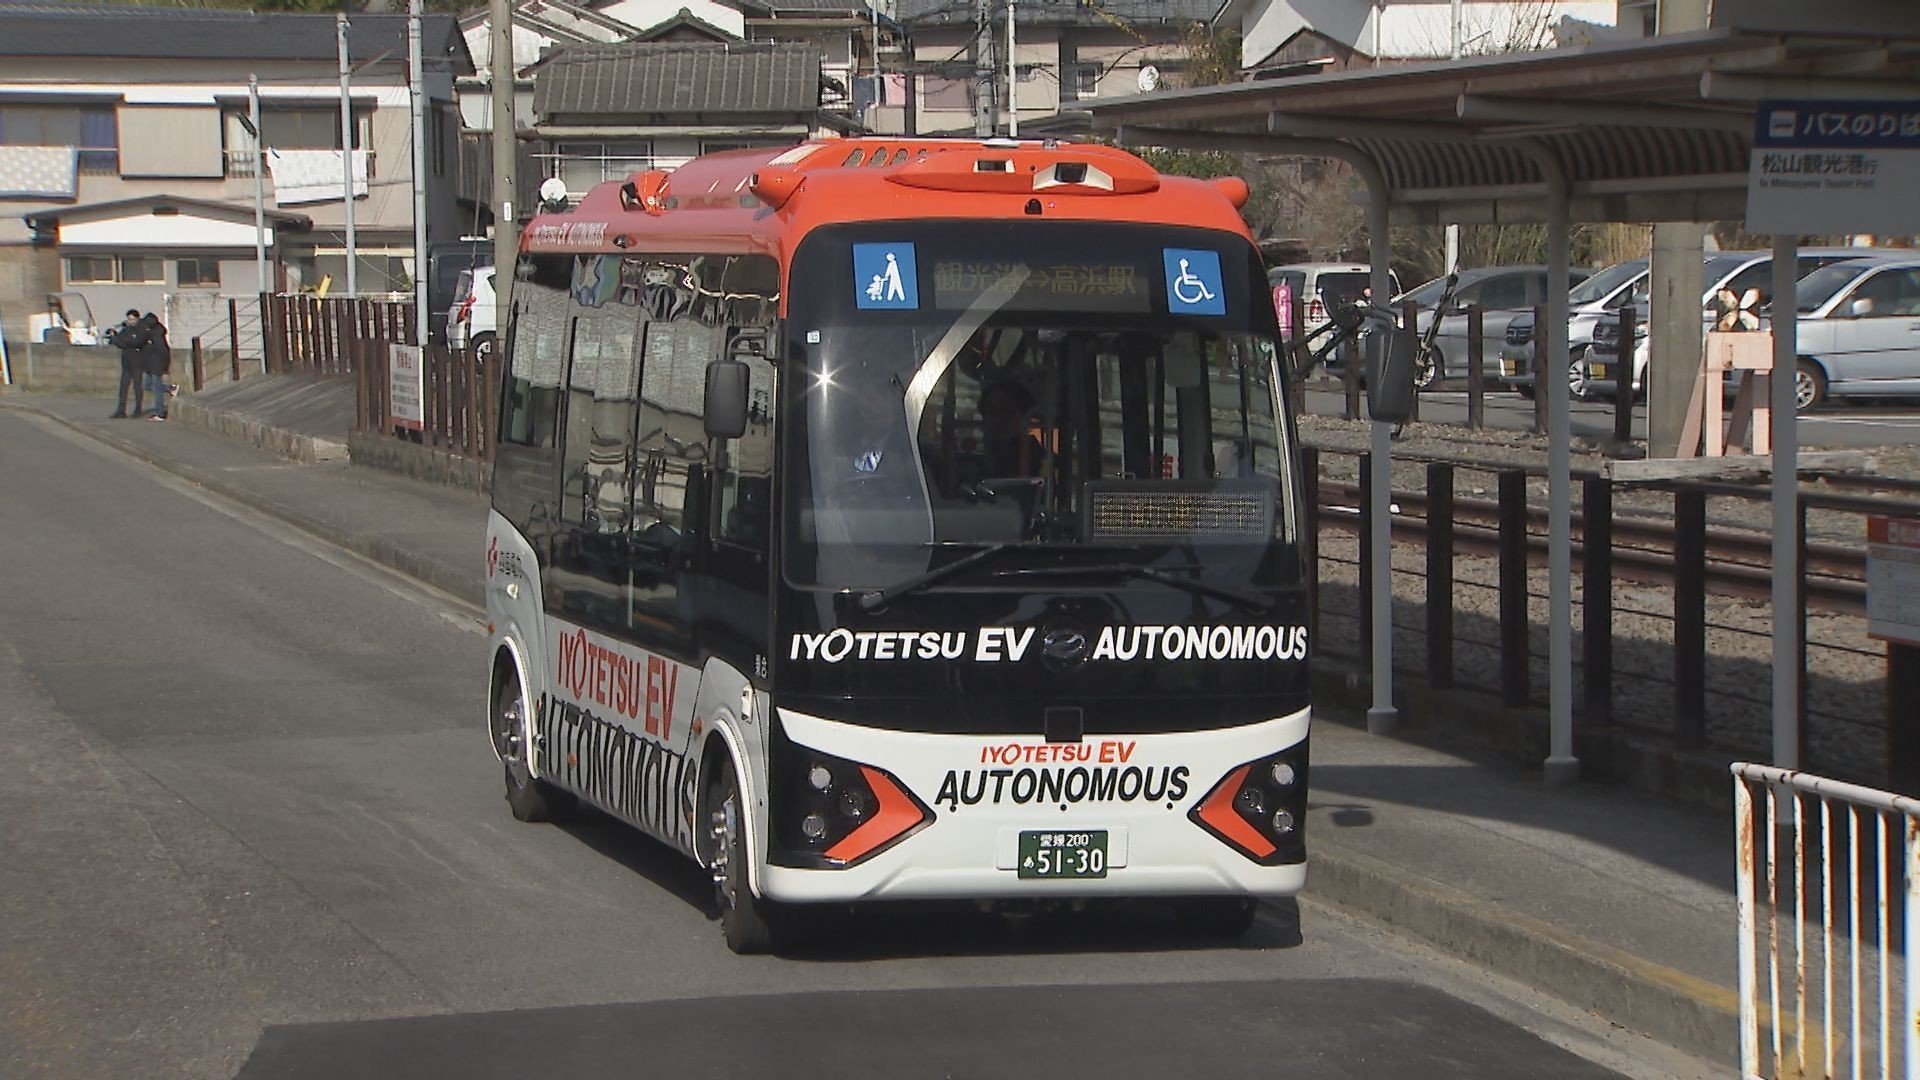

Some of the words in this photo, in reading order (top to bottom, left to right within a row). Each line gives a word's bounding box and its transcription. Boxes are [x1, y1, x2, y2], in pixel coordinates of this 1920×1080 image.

[1049, 265, 1138, 296] 高浜駅
[790, 627, 966, 663] IYOTETSU
[975, 626, 1036, 662] EV
[1092, 625, 1308, 661] AUTONOMOUS
[558, 627, 641, 720] IYOTETSU
[644, 653, 679, 741] EV
[980, 742, 1092, 766] IYOTETSU
[1098, 740, 1137, 763] EV
[934, 765, 1191, 806] AUTONOMOUS
[1066, 833, 1089, 847] 200
[1037, 848, 1104, 874] 51-30
